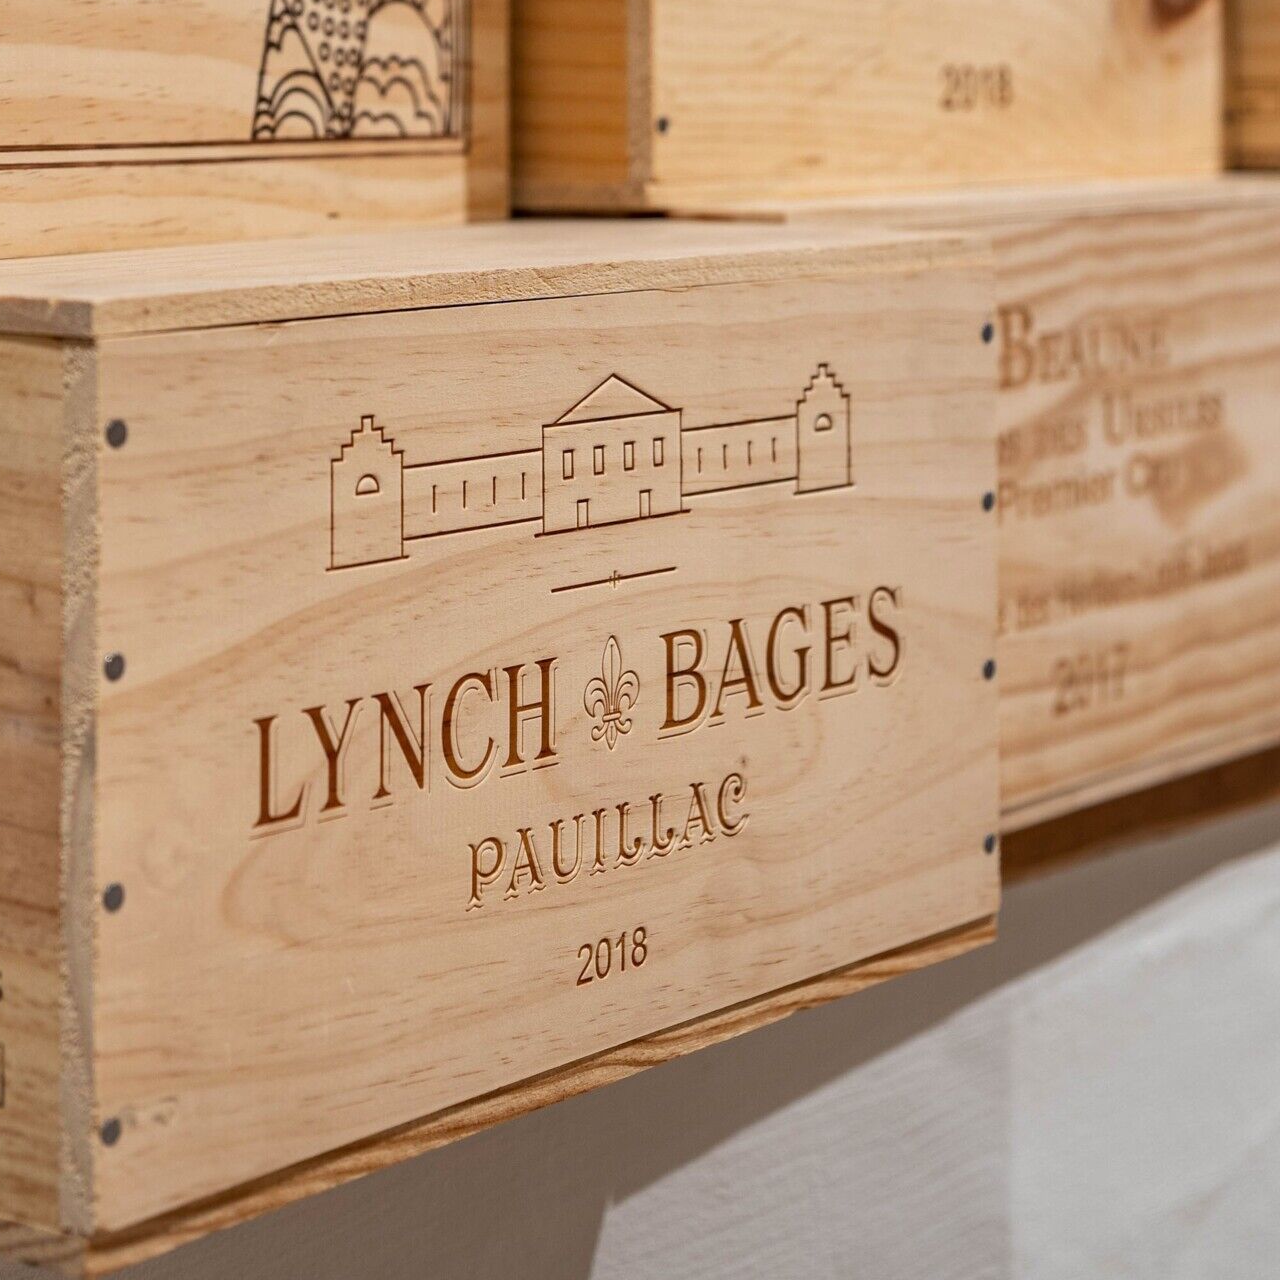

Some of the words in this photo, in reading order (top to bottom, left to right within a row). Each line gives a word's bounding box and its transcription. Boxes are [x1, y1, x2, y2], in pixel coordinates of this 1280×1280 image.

[251, 656, 558, 837] LYNCH
[658, 585, 905, 739] BAGES
[466, 771, 751, 910] PAUILLAC
[576, 925, 649, 987] 2018
